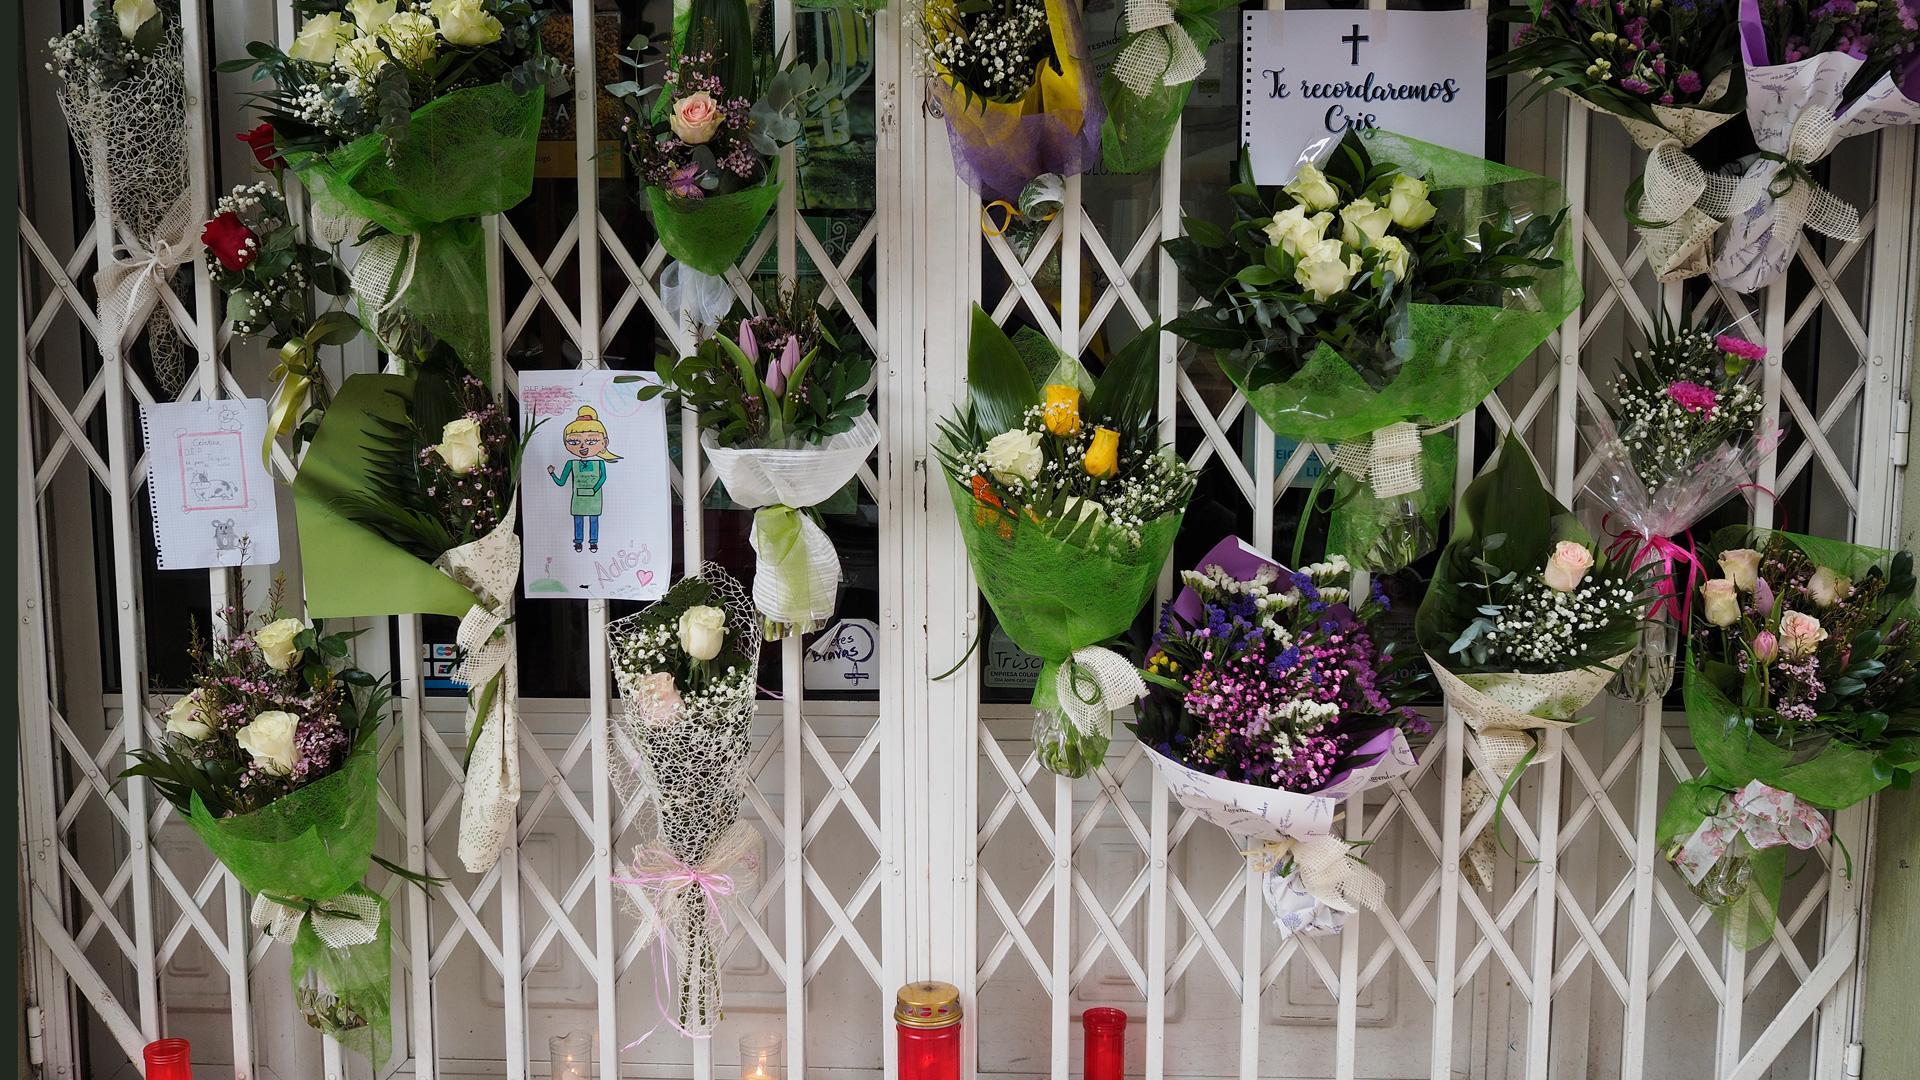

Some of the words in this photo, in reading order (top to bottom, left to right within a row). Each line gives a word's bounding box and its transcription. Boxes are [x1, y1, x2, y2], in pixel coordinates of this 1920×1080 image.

[1262, 67, 1291, 99] Te
[1300, 72, 1460, 103] recordaremos
[1324, 104, 1380, 139] Cris
[811, 646, 859, 663] Bravas
